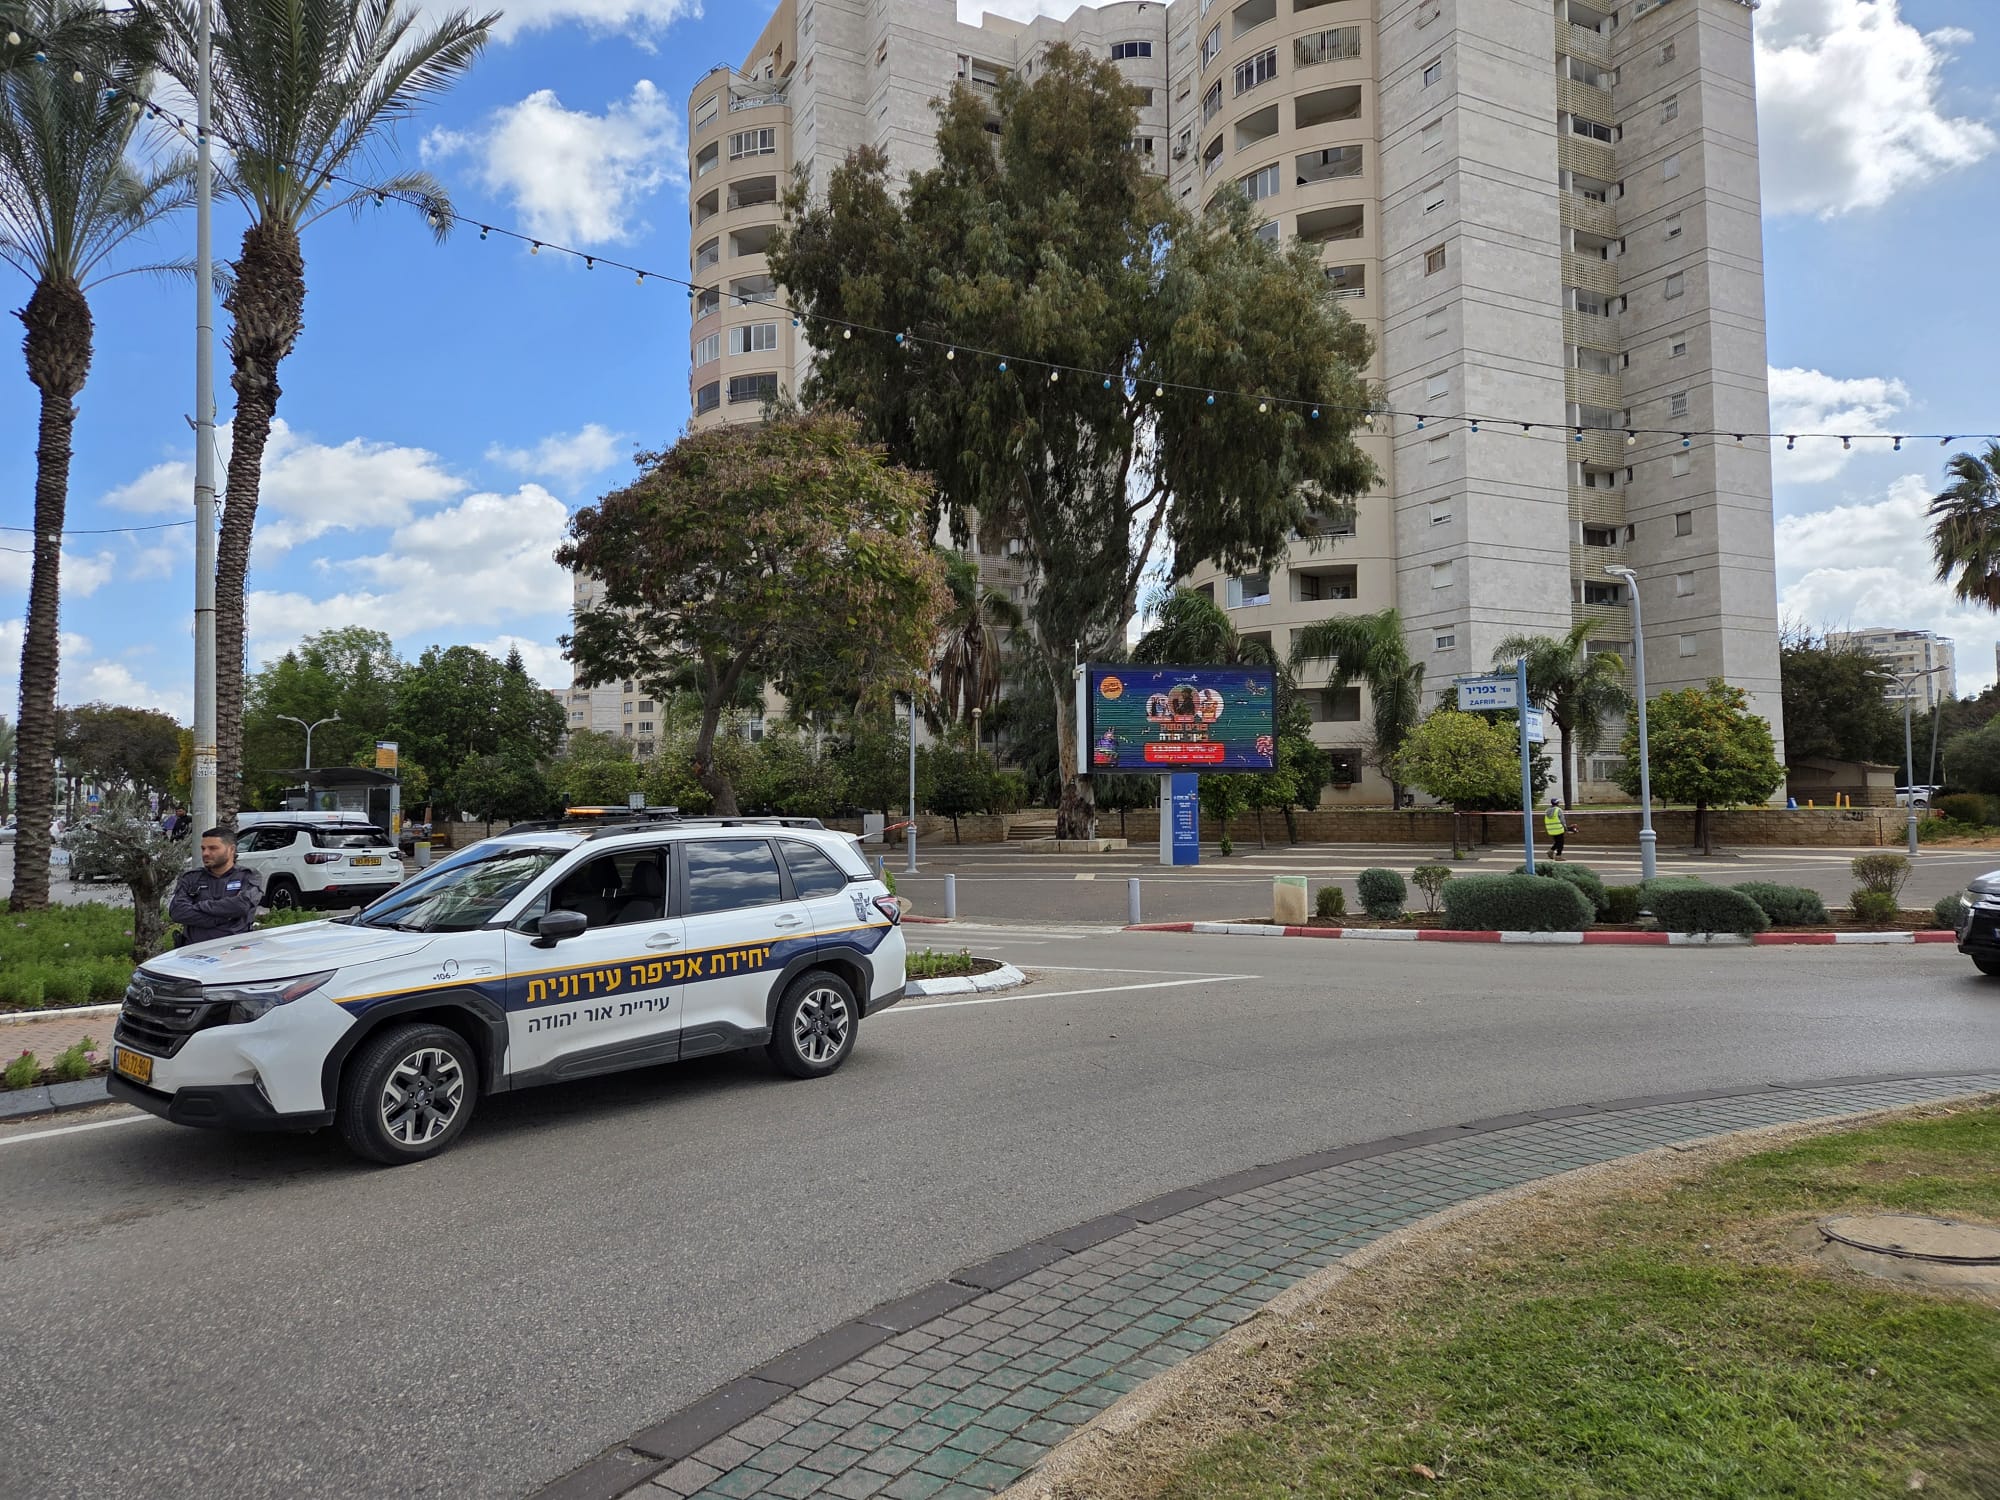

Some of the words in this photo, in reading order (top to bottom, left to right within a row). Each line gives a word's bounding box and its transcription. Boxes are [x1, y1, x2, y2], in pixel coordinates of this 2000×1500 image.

[1465, 685, 1497, 695] צפריר
[1469, 698, 1496, 706] ZAFRIR
[630, 956, 703, 986] אכיפה
[709, 947, 770, 975] יחידת
[526, 968, 622, 1003] עירונית
[584, 1006, 613, 1022] אור
[619, 996, 670, 1017] עיריית
[528, 1011, 577, 1033] יהודה
